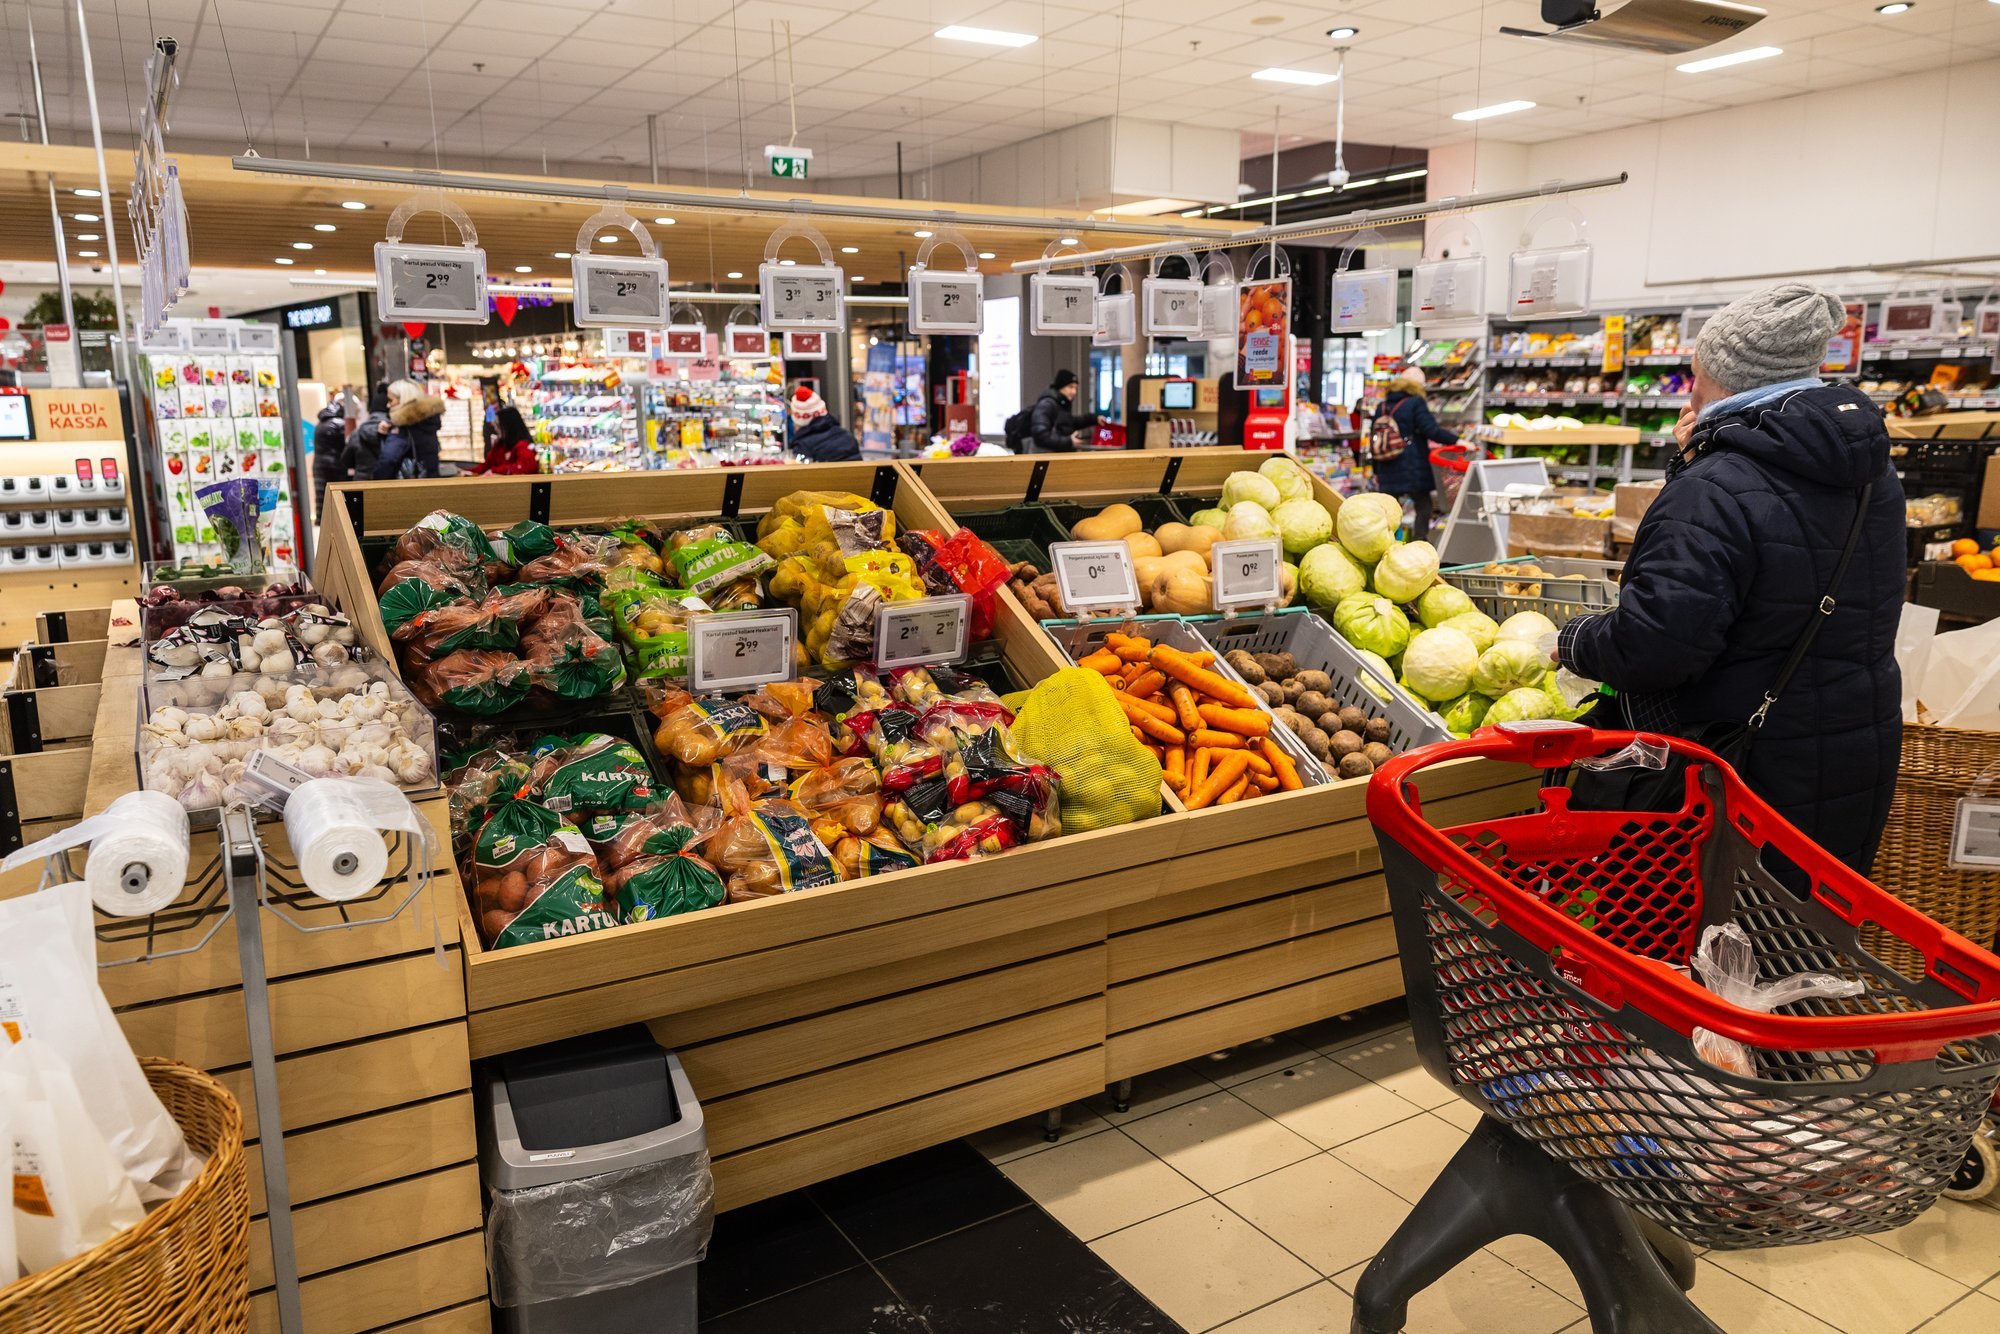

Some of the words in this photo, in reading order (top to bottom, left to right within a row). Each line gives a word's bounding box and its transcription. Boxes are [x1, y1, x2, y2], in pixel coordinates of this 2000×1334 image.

[48, 402, 105, 416] PULDI-
[50, 417, 108, 429] KASSA
[687, 546, 739, 579] KARTUL
